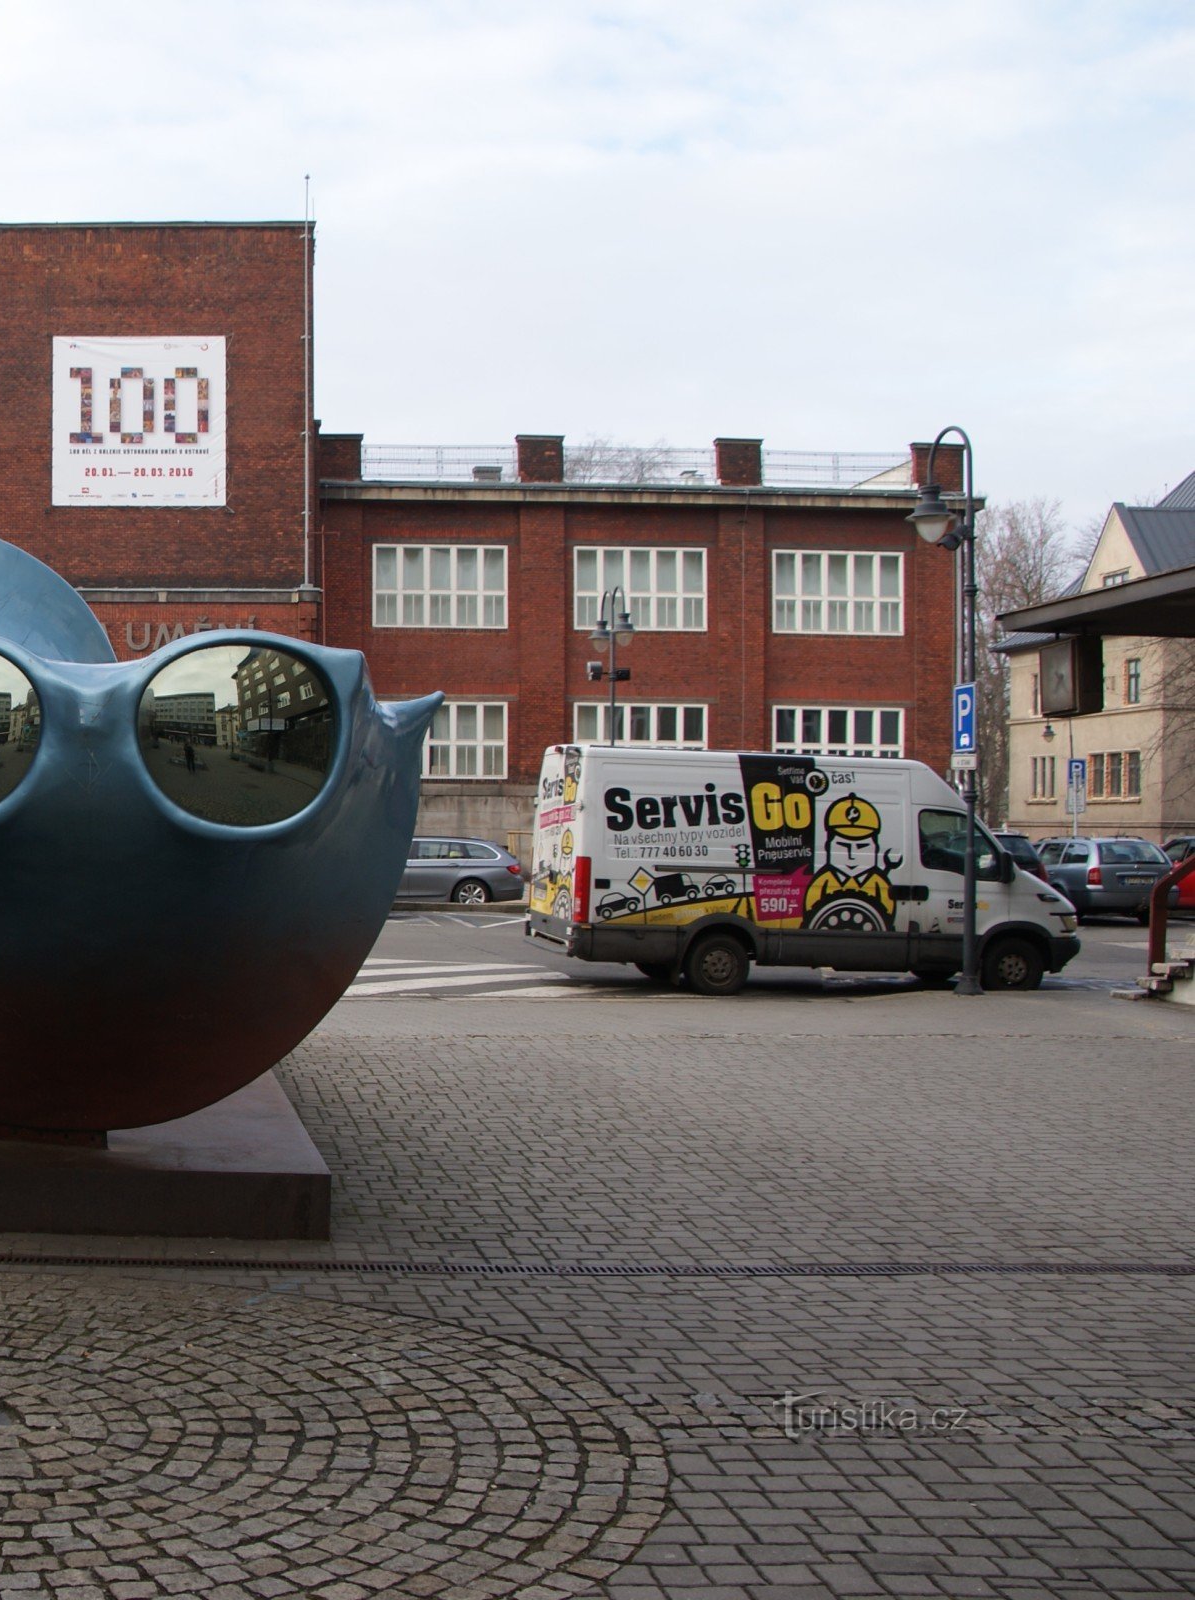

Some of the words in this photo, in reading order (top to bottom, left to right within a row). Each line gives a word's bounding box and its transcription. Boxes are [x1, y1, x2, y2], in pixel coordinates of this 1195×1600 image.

[69, 367, 209, 444] 100
[958, 693, 971, 731] P
[831, 771, 856, 784] čas!
[605, 783, 745, 831] Servis
[751, 782, 811, 831] Go
[614, 834, 629, 845] Na
[631, 831, 678, 844] všechny
[680, 830, 703, 843] typy
[706, 825, 746, 839] vozidel
[765, 834, 802, 849] Mobilní
[640, 847, 660, 858] 777
[663, 846, 677, 857] 40
[679, 846, 692, 857] 60
[695, 845, 709, 857] 30
[758, 847, 812, 863] Pneuservis
